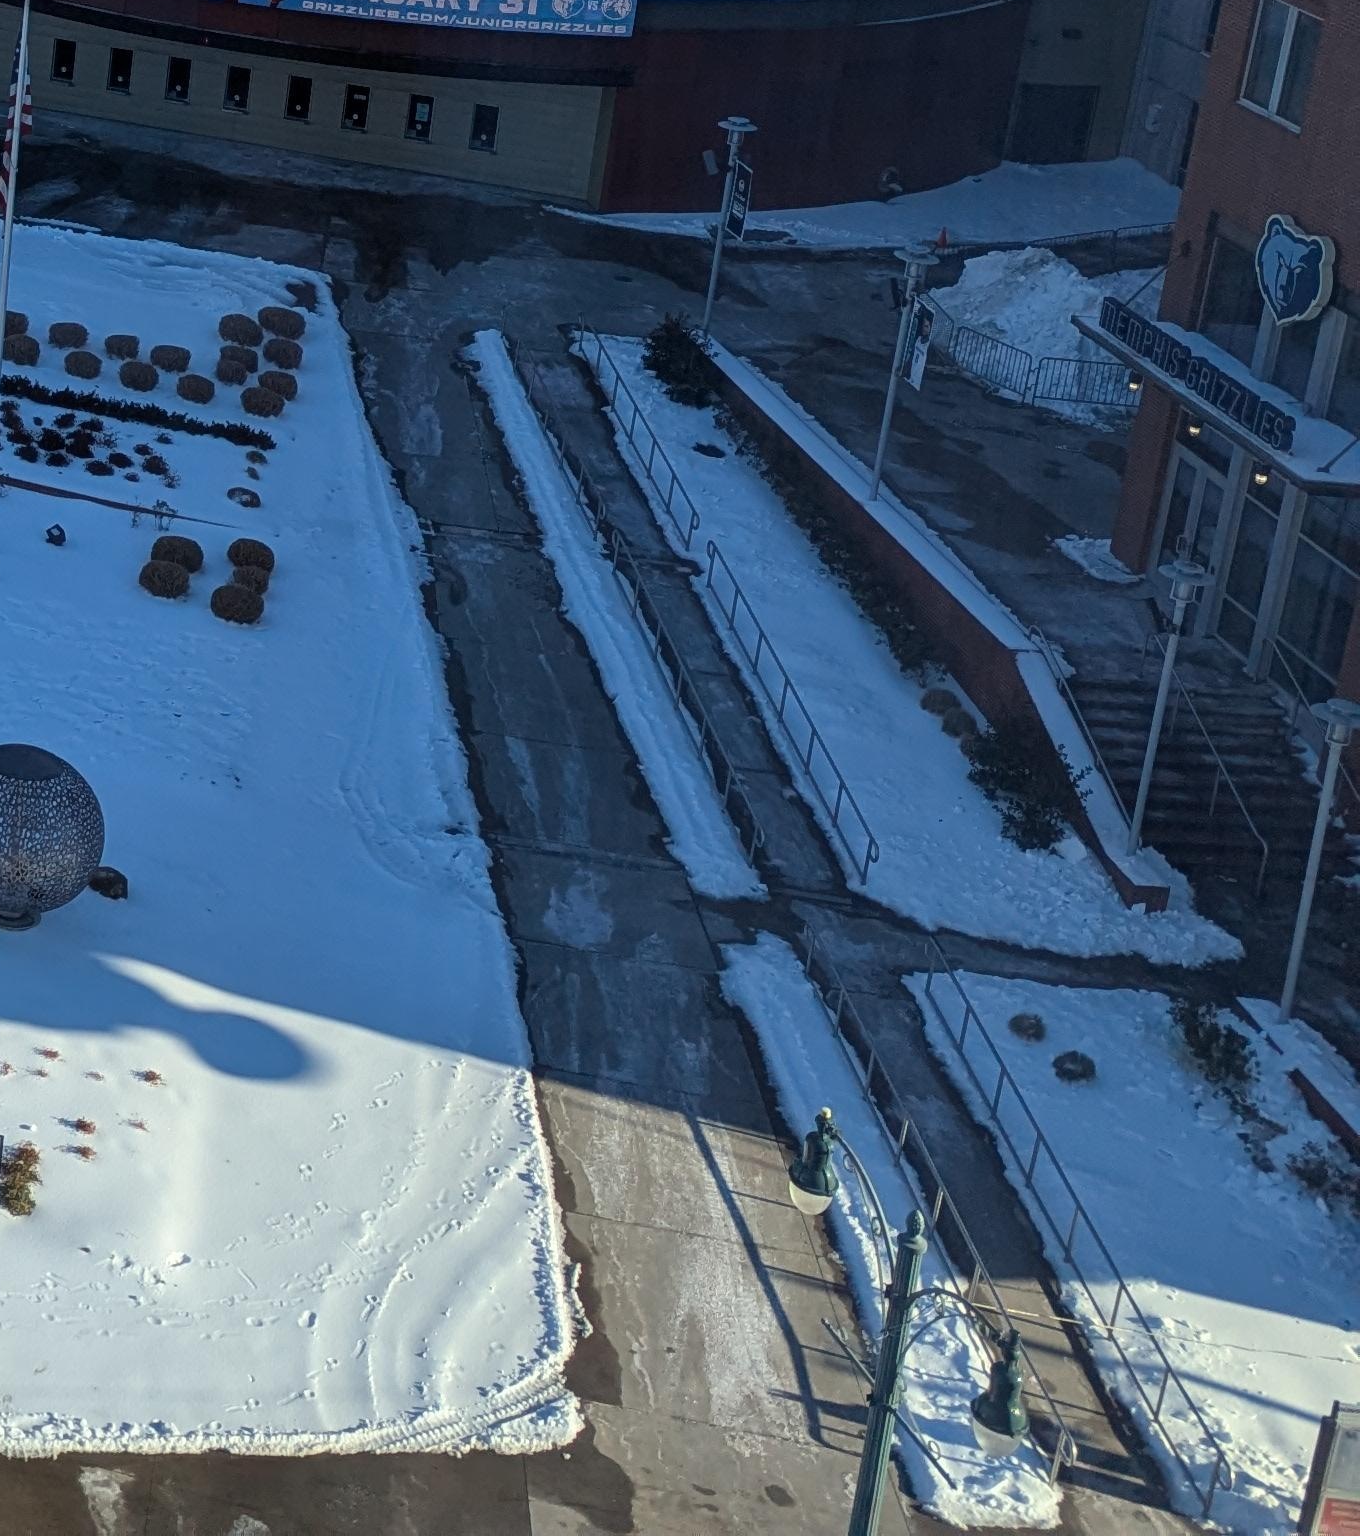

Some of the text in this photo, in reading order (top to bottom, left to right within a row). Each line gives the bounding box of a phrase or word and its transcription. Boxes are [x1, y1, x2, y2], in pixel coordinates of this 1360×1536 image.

[302, 0, 628, 34] GRIZZLIES.COM/JUNIORGRIZZLIES
[1099, 298, 1291, 450] MEMPHIS GRIZZLIES
